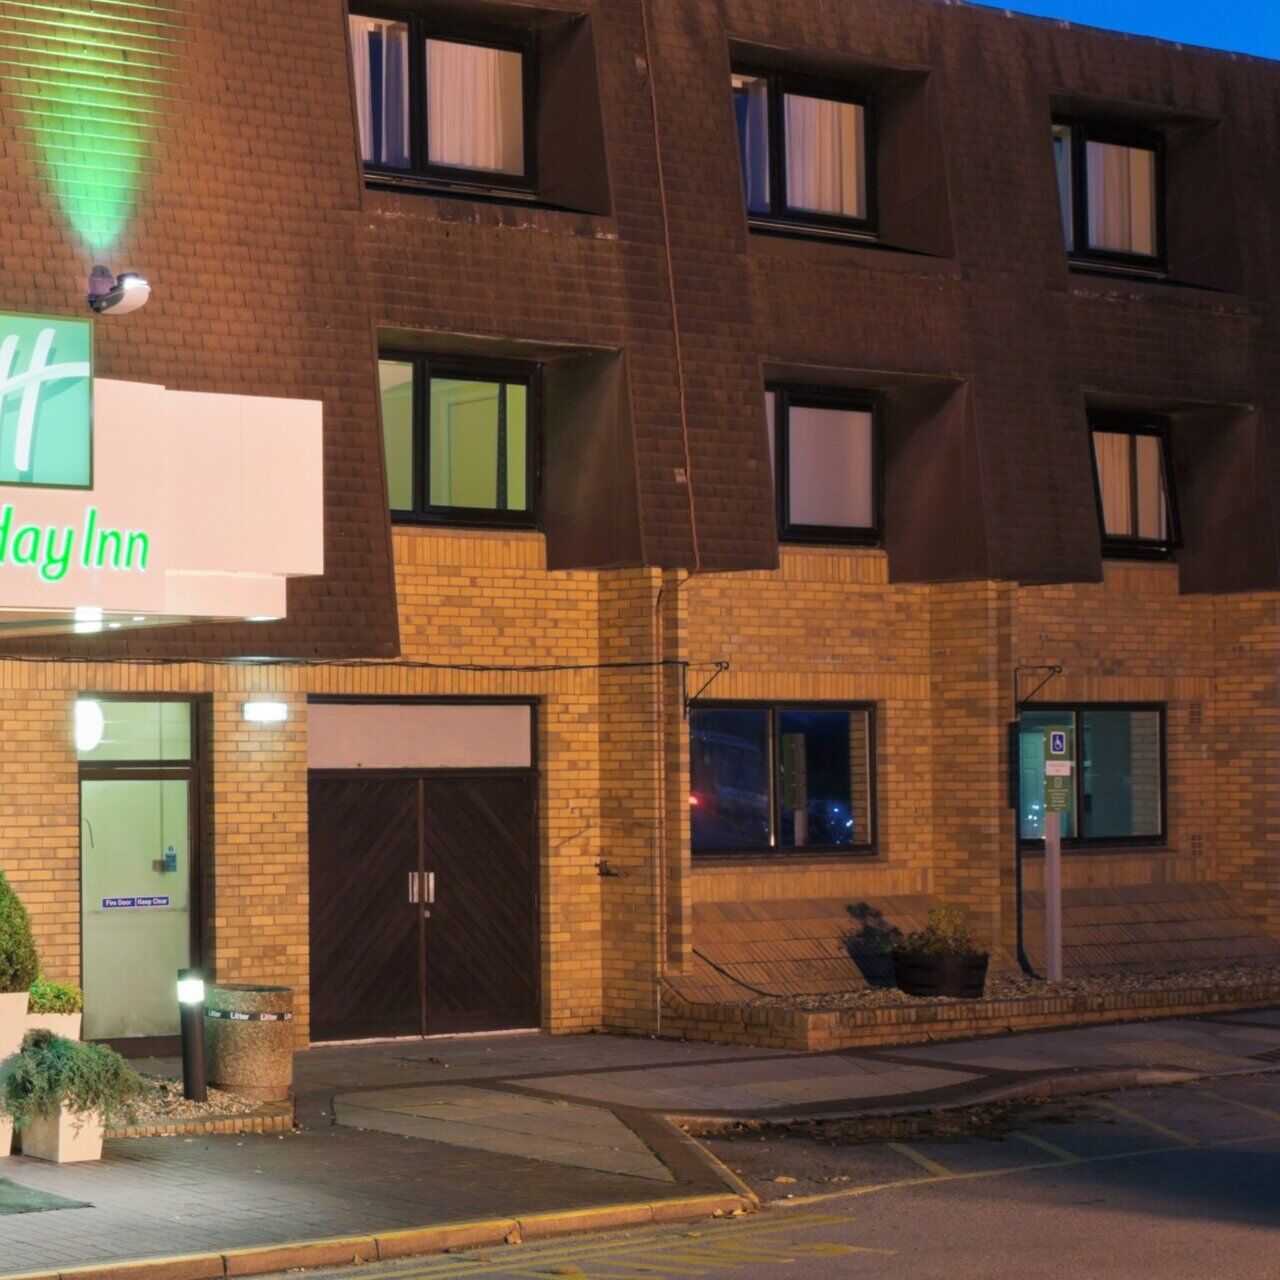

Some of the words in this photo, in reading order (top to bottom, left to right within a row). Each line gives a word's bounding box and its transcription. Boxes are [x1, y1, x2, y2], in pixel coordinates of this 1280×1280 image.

[80, 506, 151, 570] Inn
[230, 1012, 250, 1020] Litter
[260, 1013, 277, 1021] Litter
